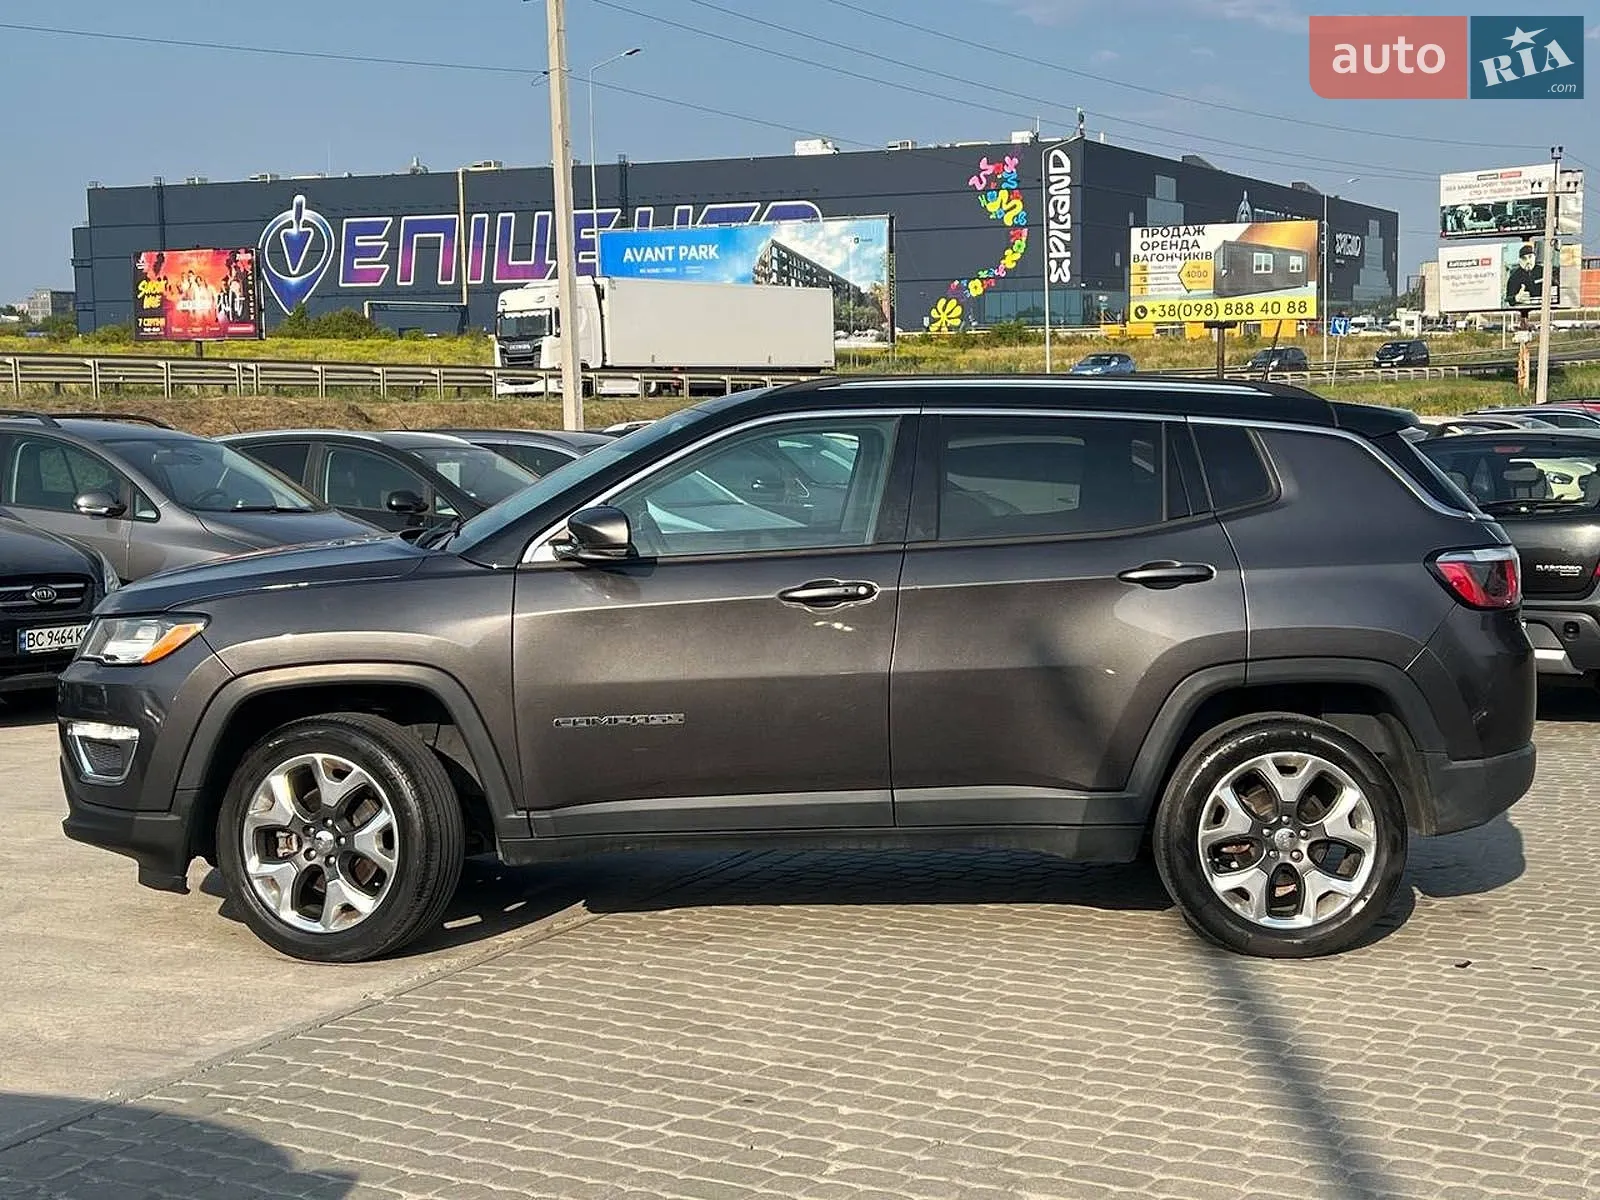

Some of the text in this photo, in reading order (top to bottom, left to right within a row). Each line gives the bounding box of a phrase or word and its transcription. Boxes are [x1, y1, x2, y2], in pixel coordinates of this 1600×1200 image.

[1140, 225, 1206, 239] ПРОДАЖ
[1140, 239, 1201, 252] ОРЕНДА
[622, 243, 720, 263] AVANT PARK
[1132, 251, 1213, 263] ВАГОНЧИКІВ
[1150, 300, 1307, 320] +38(098) 888 40 88
[36, 590, 53, 600] KIA
[27, 632, 45, 648] BC
[47, 628, 74, 645] 9464
